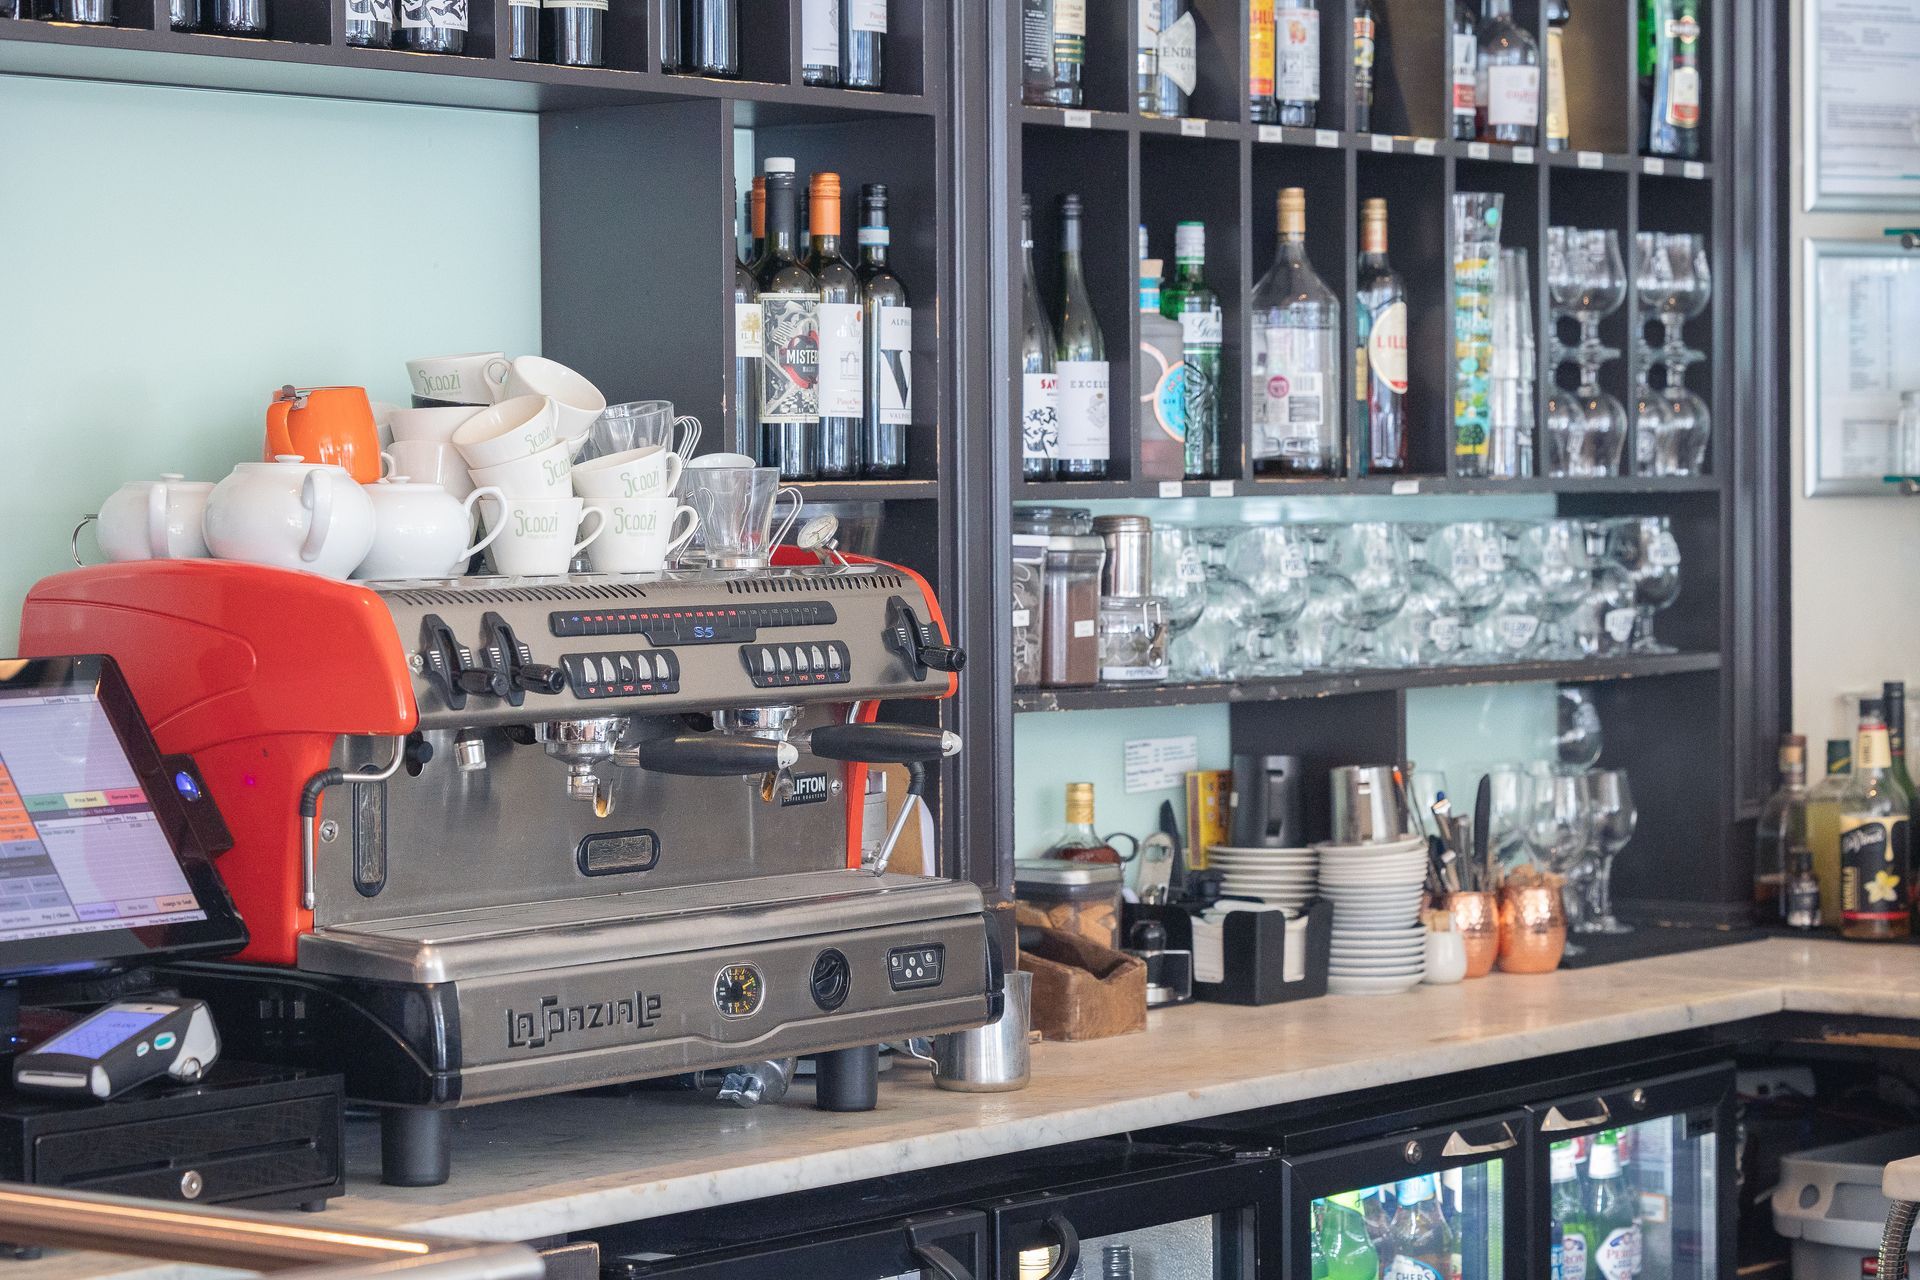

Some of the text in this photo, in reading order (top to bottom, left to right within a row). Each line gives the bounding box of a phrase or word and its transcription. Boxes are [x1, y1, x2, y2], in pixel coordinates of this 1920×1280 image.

[418, 368, 462, 395] Scoozi
[620, 466, 660, 498] Scoozi
[513, 509, 559, 537] Scoozi
[613, 507, 657, 534] Scoozi
[693, 626, 715, 638] S5
